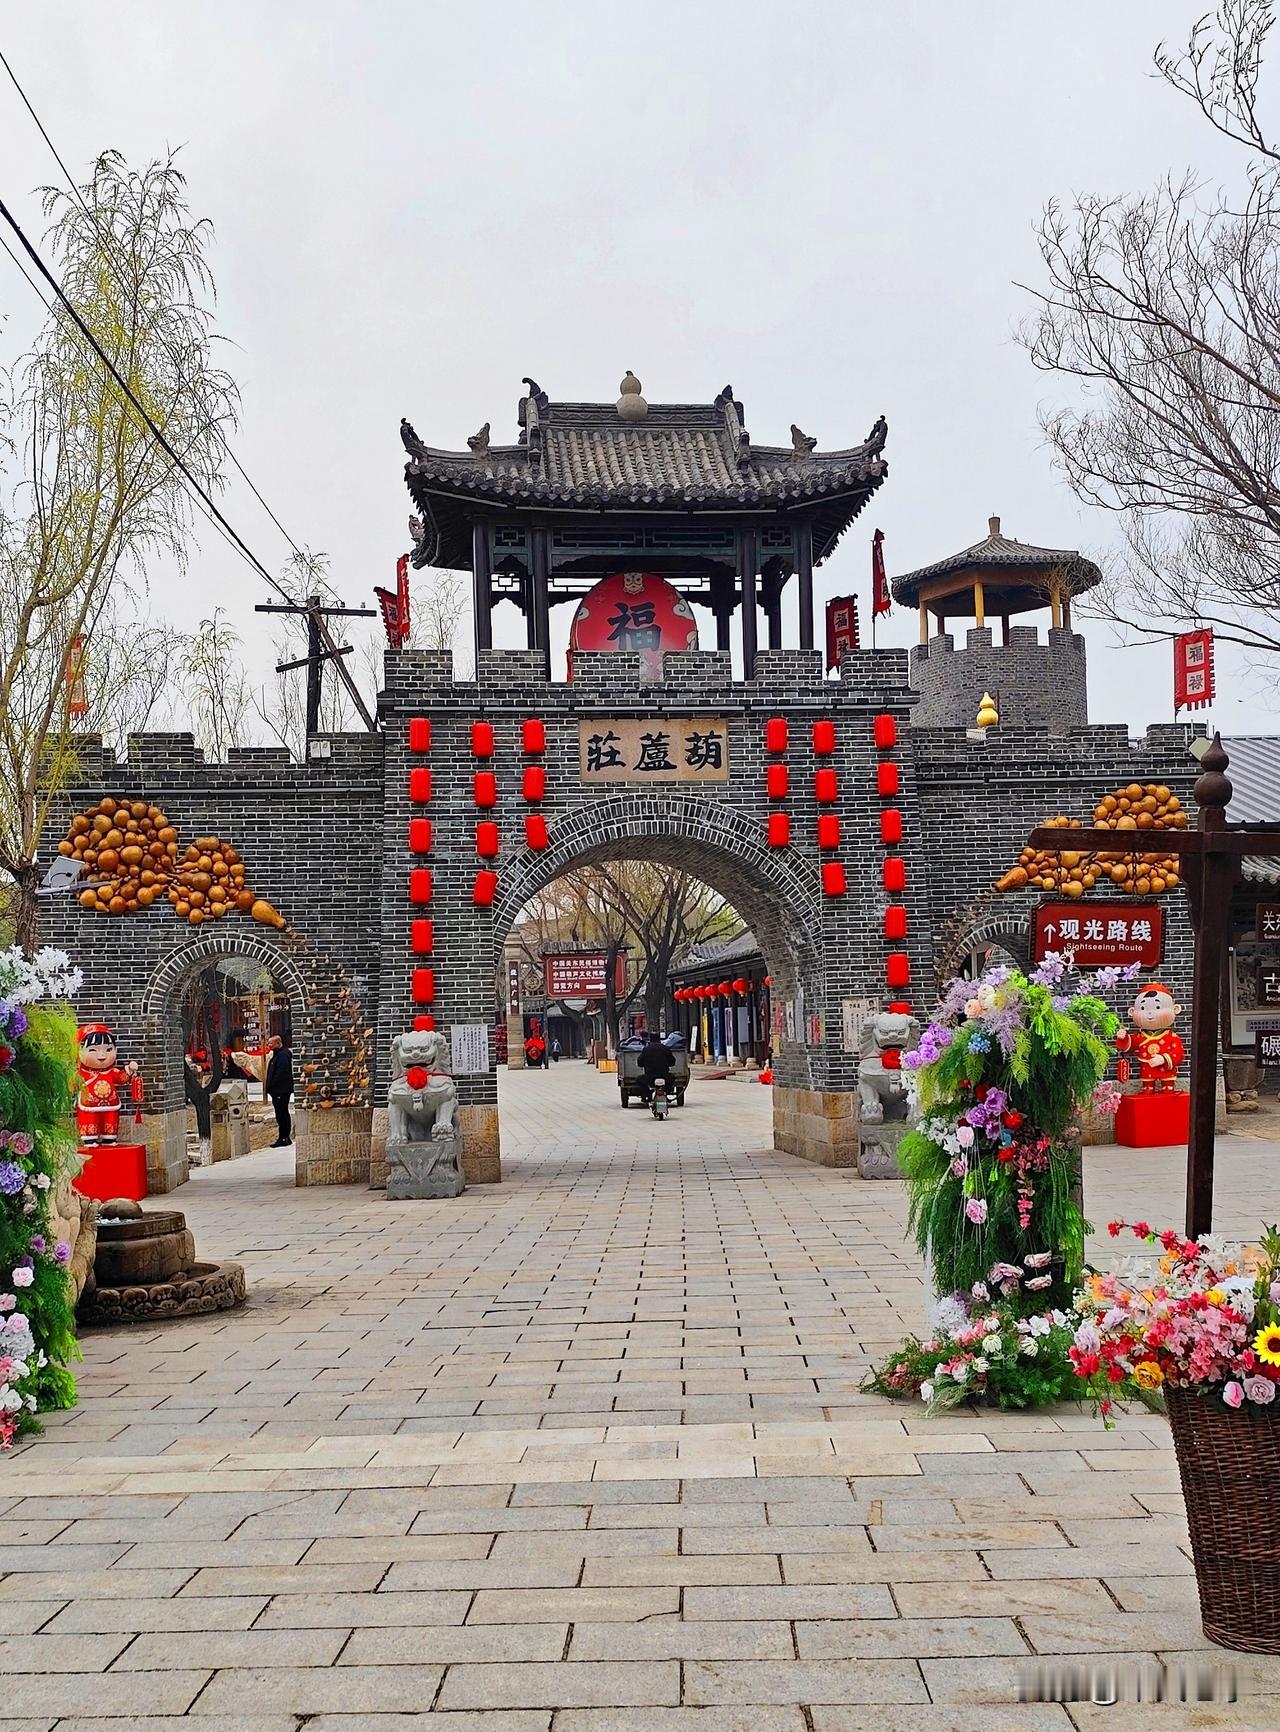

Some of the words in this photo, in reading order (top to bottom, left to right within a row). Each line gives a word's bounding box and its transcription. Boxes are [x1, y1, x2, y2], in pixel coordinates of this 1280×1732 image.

[606, 601, 661, 651] 福
[1188, 645, 1204, 691] 福禄
[1058, 919, 1152, 942] 观光路线
[1066, 942, 1116, 952] Sightseeing
[1119, 943, 1143, 951] Route
